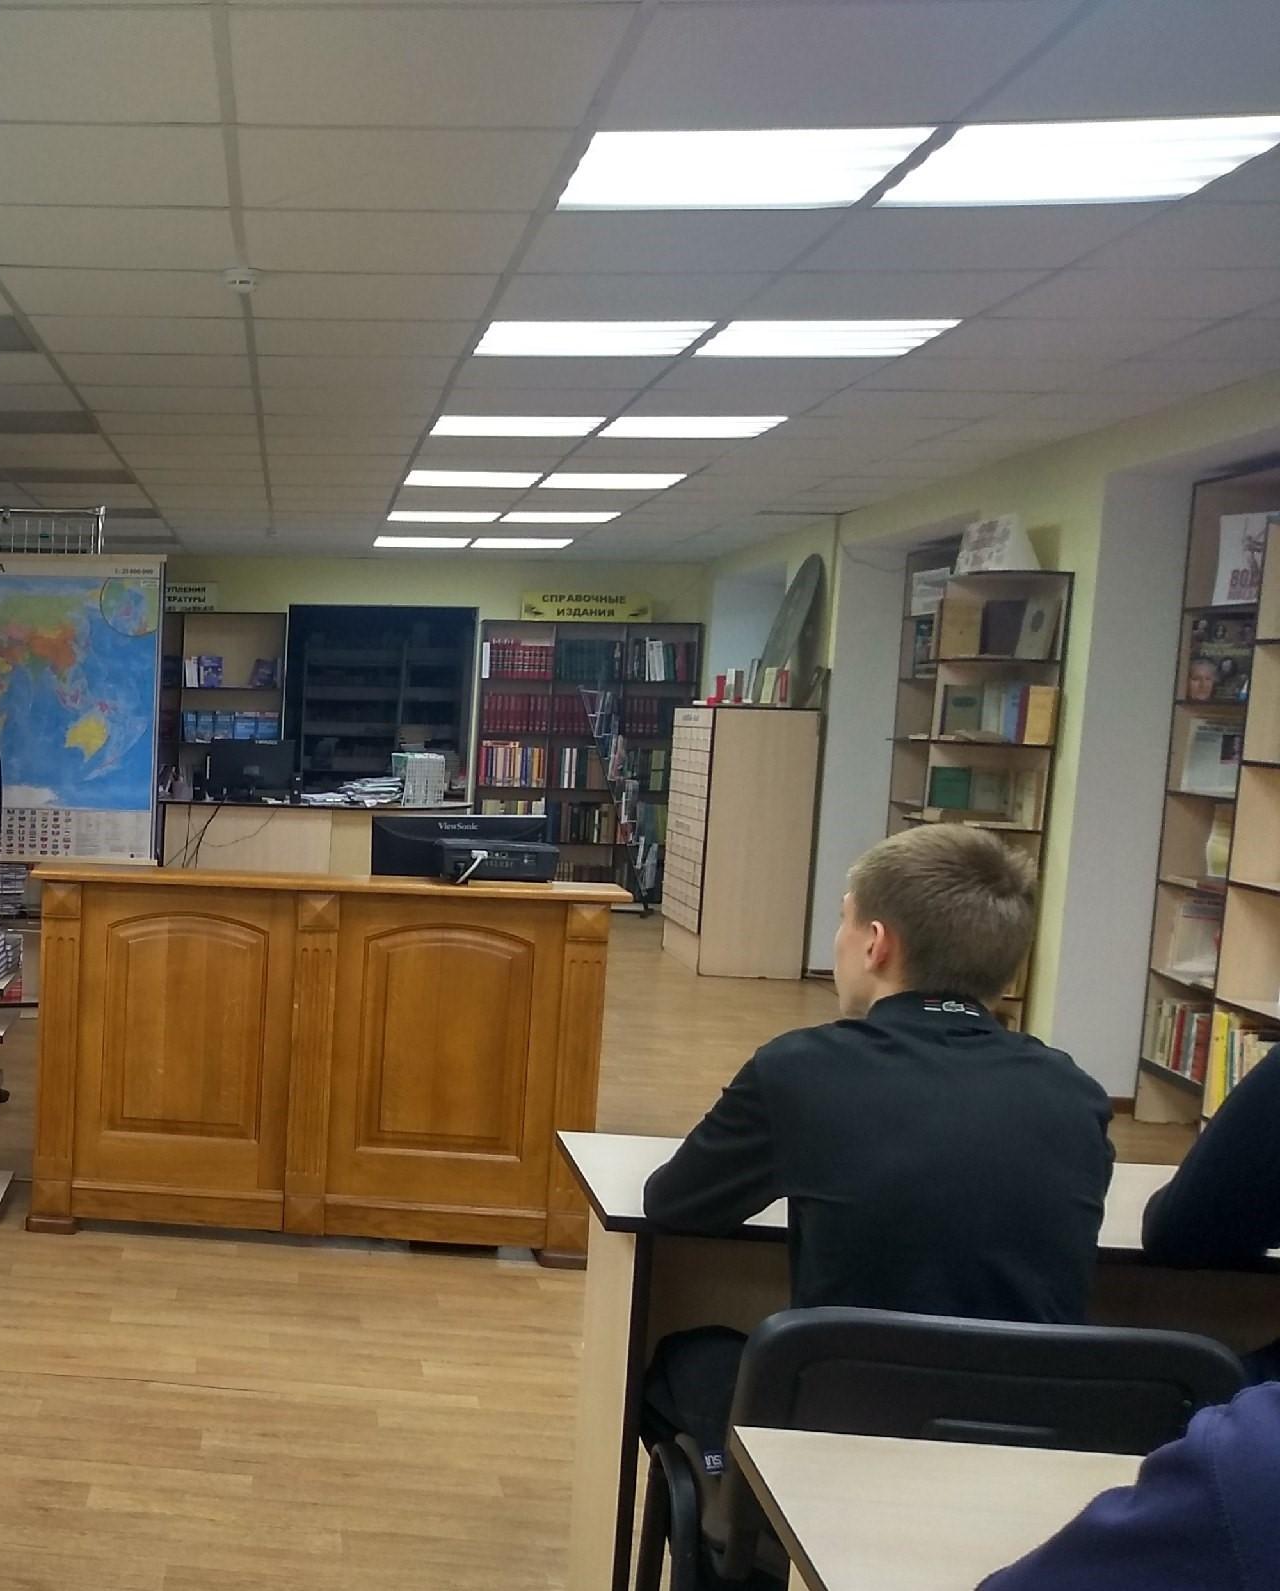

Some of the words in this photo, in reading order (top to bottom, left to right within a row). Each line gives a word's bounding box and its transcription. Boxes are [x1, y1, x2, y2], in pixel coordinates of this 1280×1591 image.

[541, 593, 627, 605] СПРАВОЧНЫЕ
[556, 607, 615, 618] ИЗДАНИЯ
[437, 821, 479, 831] ViewSonic
